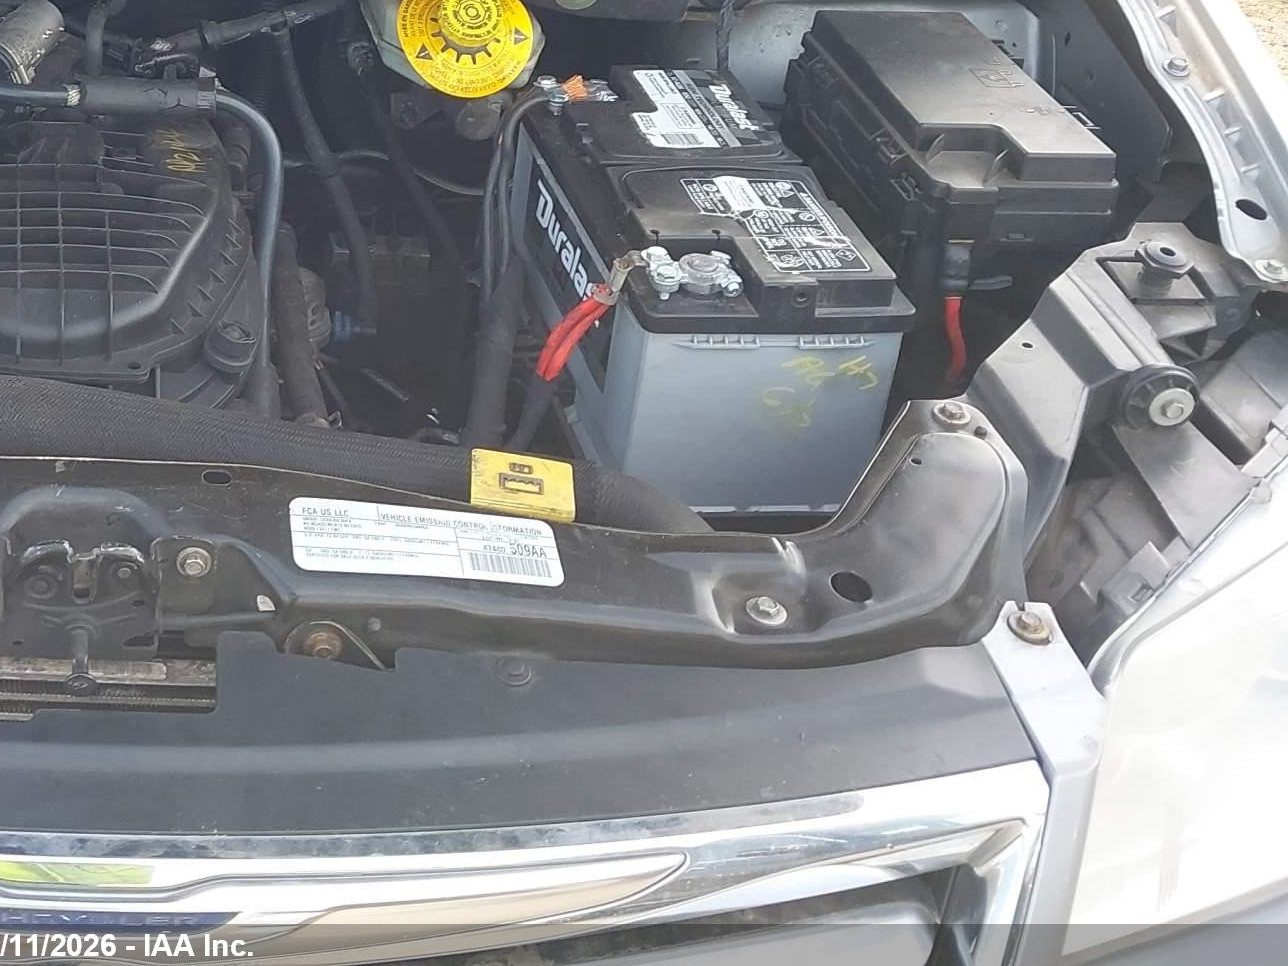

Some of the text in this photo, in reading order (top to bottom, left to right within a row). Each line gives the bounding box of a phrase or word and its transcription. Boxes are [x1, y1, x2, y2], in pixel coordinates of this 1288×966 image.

[708, 83, 760, 131] Duralast
[302, 507, 318, 515] FCA
[320, 508, 331, 516] US
[380, 514, 412, 523] VEHICLE
